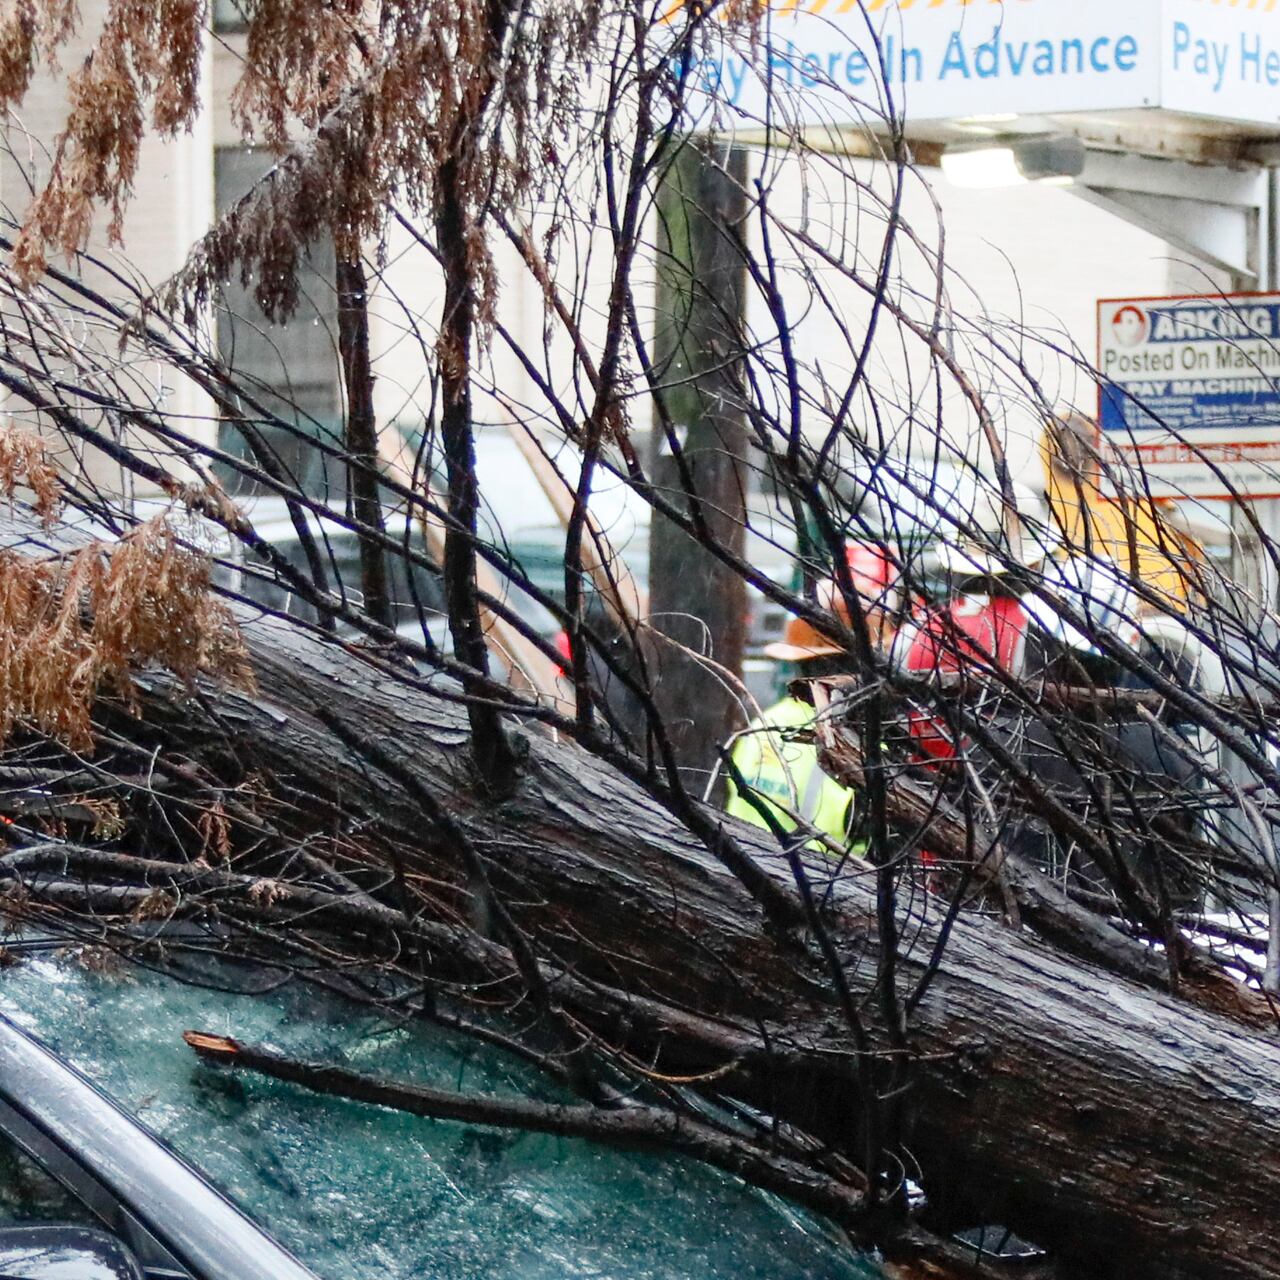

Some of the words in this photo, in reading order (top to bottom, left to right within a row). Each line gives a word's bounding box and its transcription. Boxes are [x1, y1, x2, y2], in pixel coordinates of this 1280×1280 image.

[767, 38, 866, 92] Here
[884, 35, 924, 84] In
[938, 26, 1139, 80] Advance
[1172, 21, 1228, 92] Pay
[1104, 345, 1175, 374] Posted
[1181, 345, 1210, 370] On
